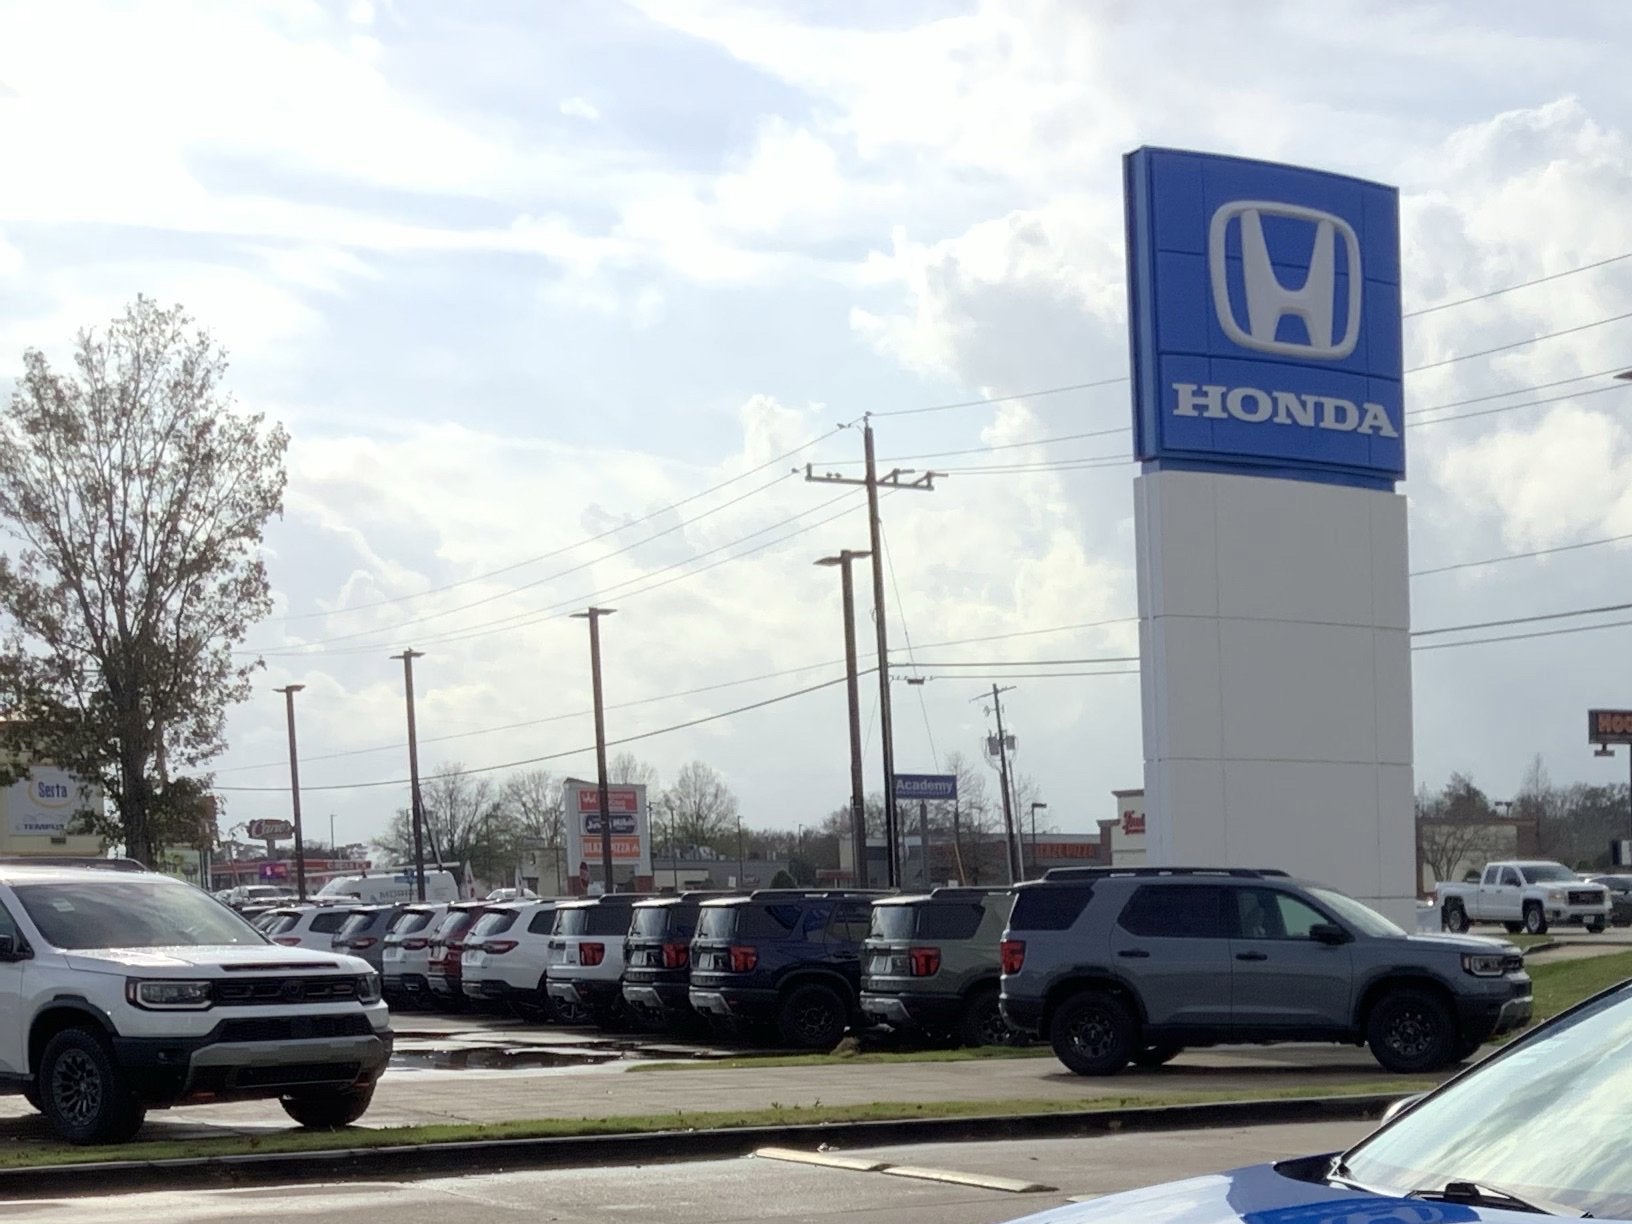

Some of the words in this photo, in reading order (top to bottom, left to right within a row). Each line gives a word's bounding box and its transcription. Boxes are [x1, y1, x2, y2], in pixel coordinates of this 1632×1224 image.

[1172, 383, 1399, 438] HONDA
[38, 782, 68, 798] Serta
[897, 779, 953, 794] Academy
